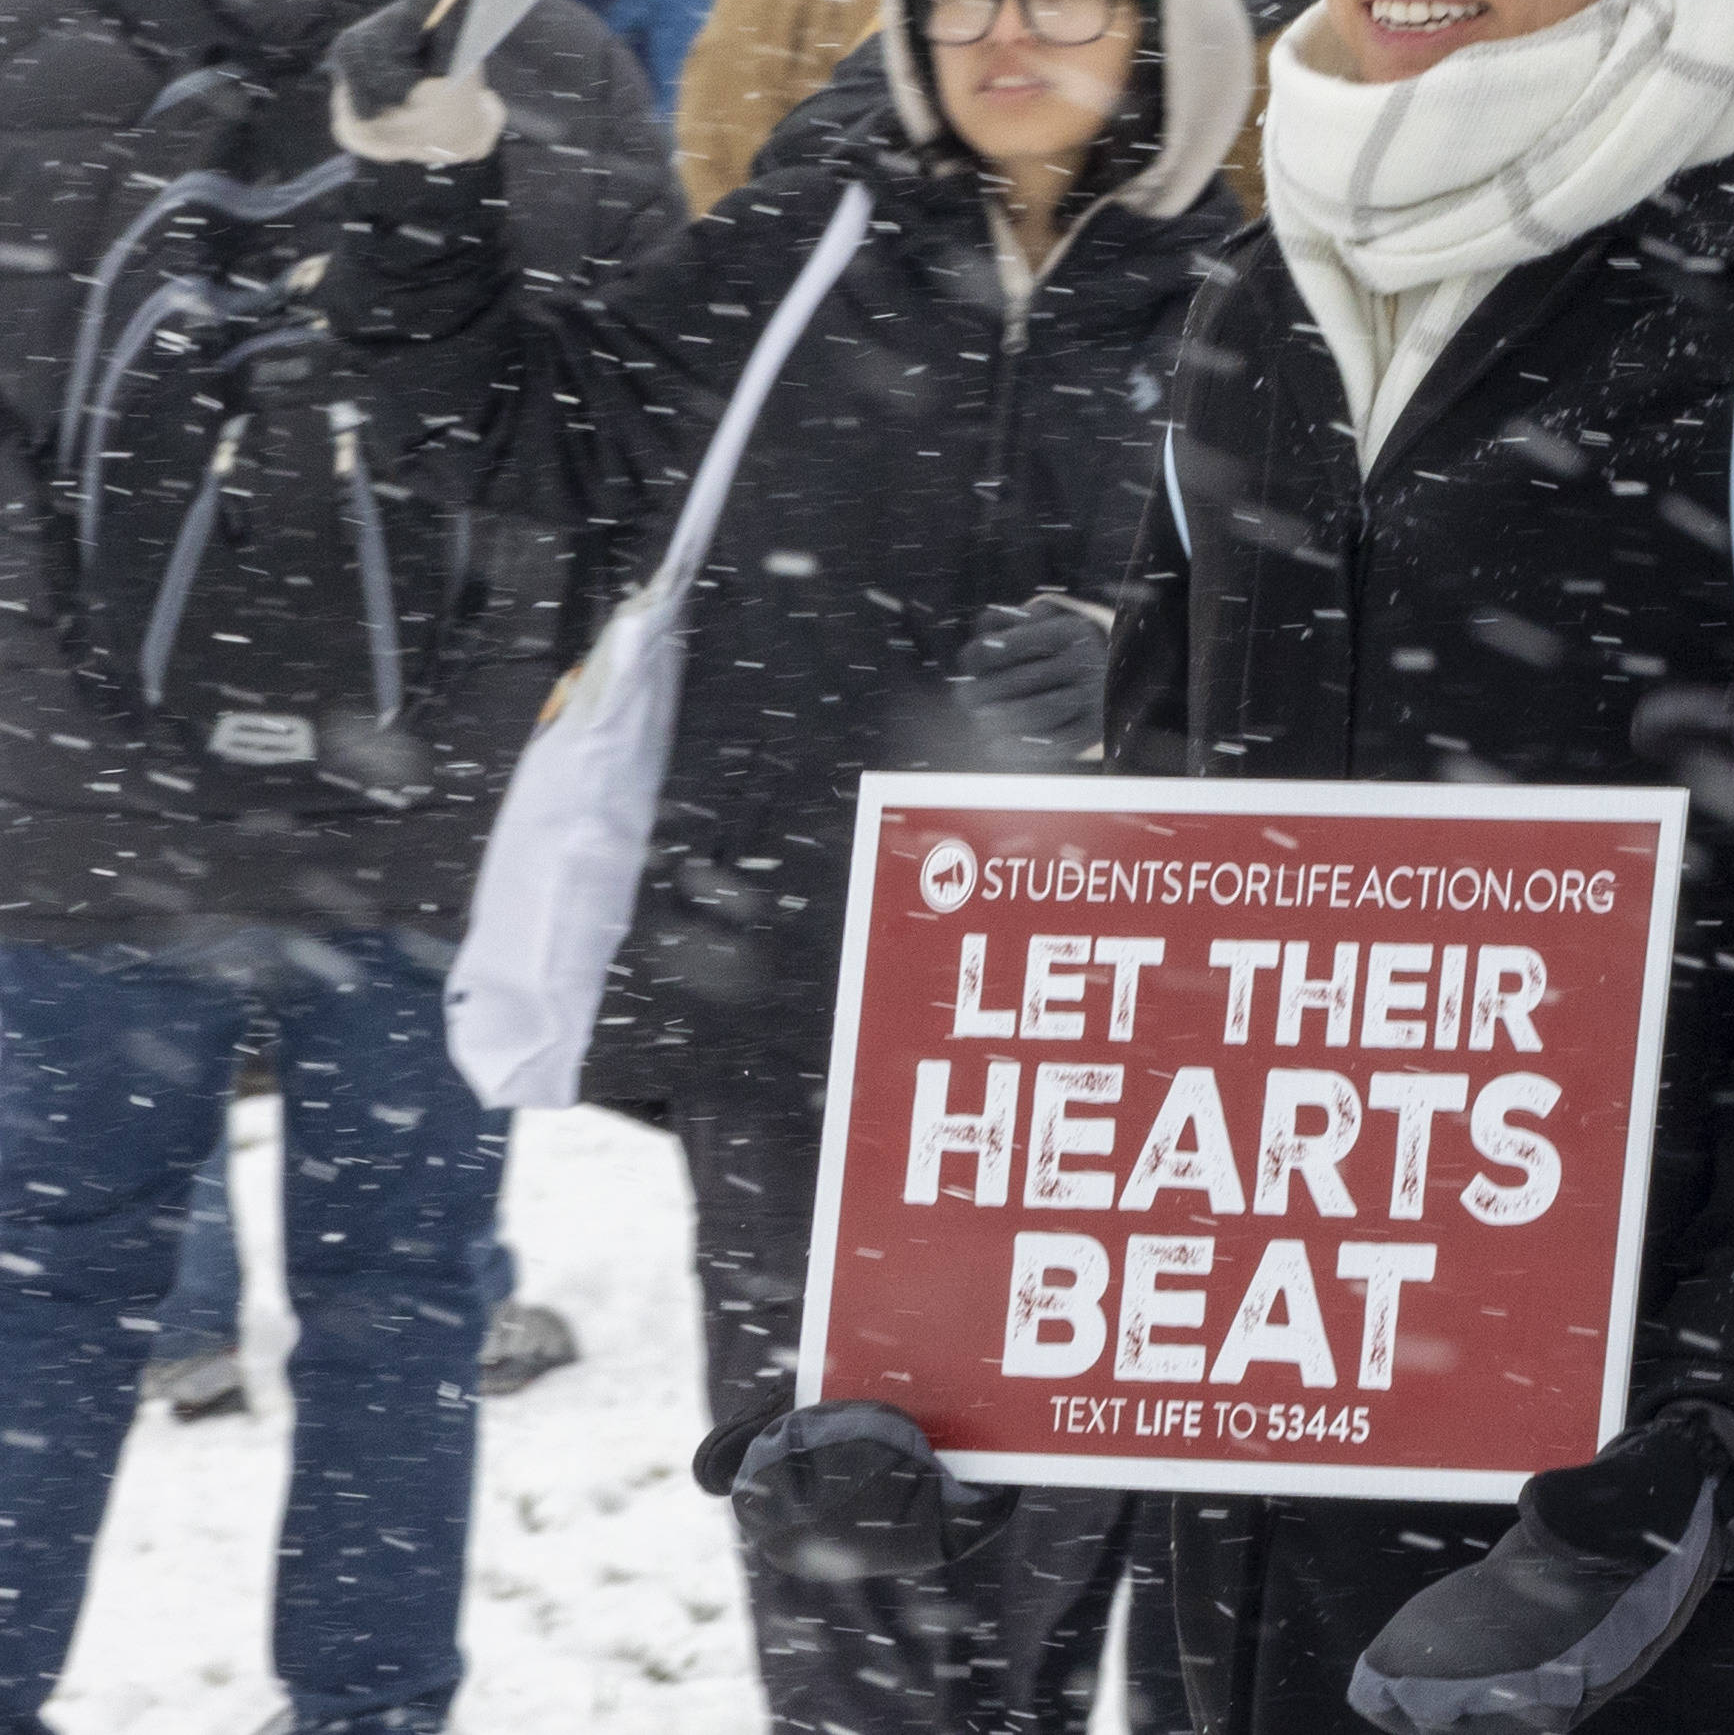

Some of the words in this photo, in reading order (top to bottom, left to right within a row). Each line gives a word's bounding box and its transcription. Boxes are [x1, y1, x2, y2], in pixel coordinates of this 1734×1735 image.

[981, 857, 1616, 914] STUDENTSFORLIFEACTION.ORG
[953, 933, 1165, 1042] LET
[1208, 939, 1547, 1053] THEIR
[904, 1059, 1562, 1226] HEARTS
[1001, 1231, 1437, 1390] BEAT
[1050, 1396, 1127, 1435] TEXT
[1136, 1398, 1203, 1437] LIFE
[1213, 1401, 1258, 1440] TO
[1267, 1404, 1371, 1444] 53445
